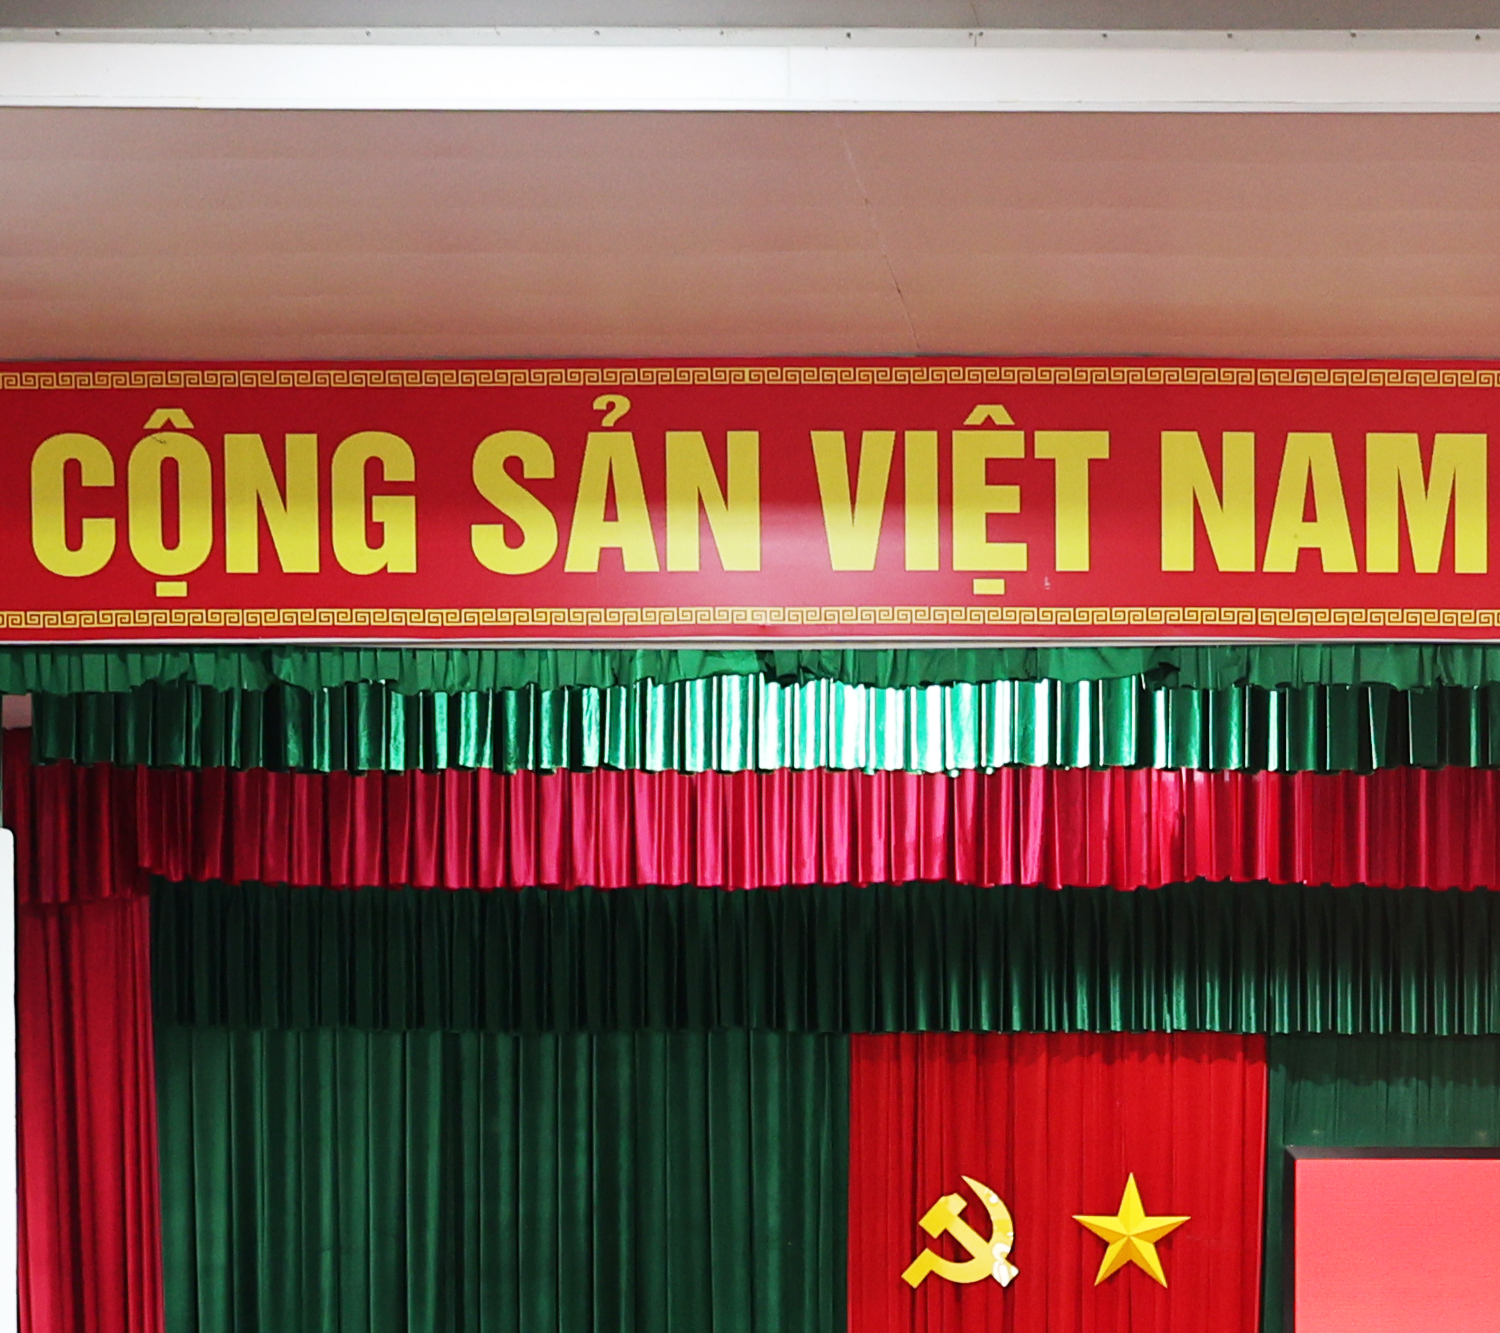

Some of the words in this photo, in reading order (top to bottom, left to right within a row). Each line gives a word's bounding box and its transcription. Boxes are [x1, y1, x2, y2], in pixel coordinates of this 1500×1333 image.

[32, 409, 416, 597] CỘNG
[471, 395, 761, 575] SẢN
[813, 405, 1109, 595] VIỆT
[1161, 431, 1487, 573] NAM
